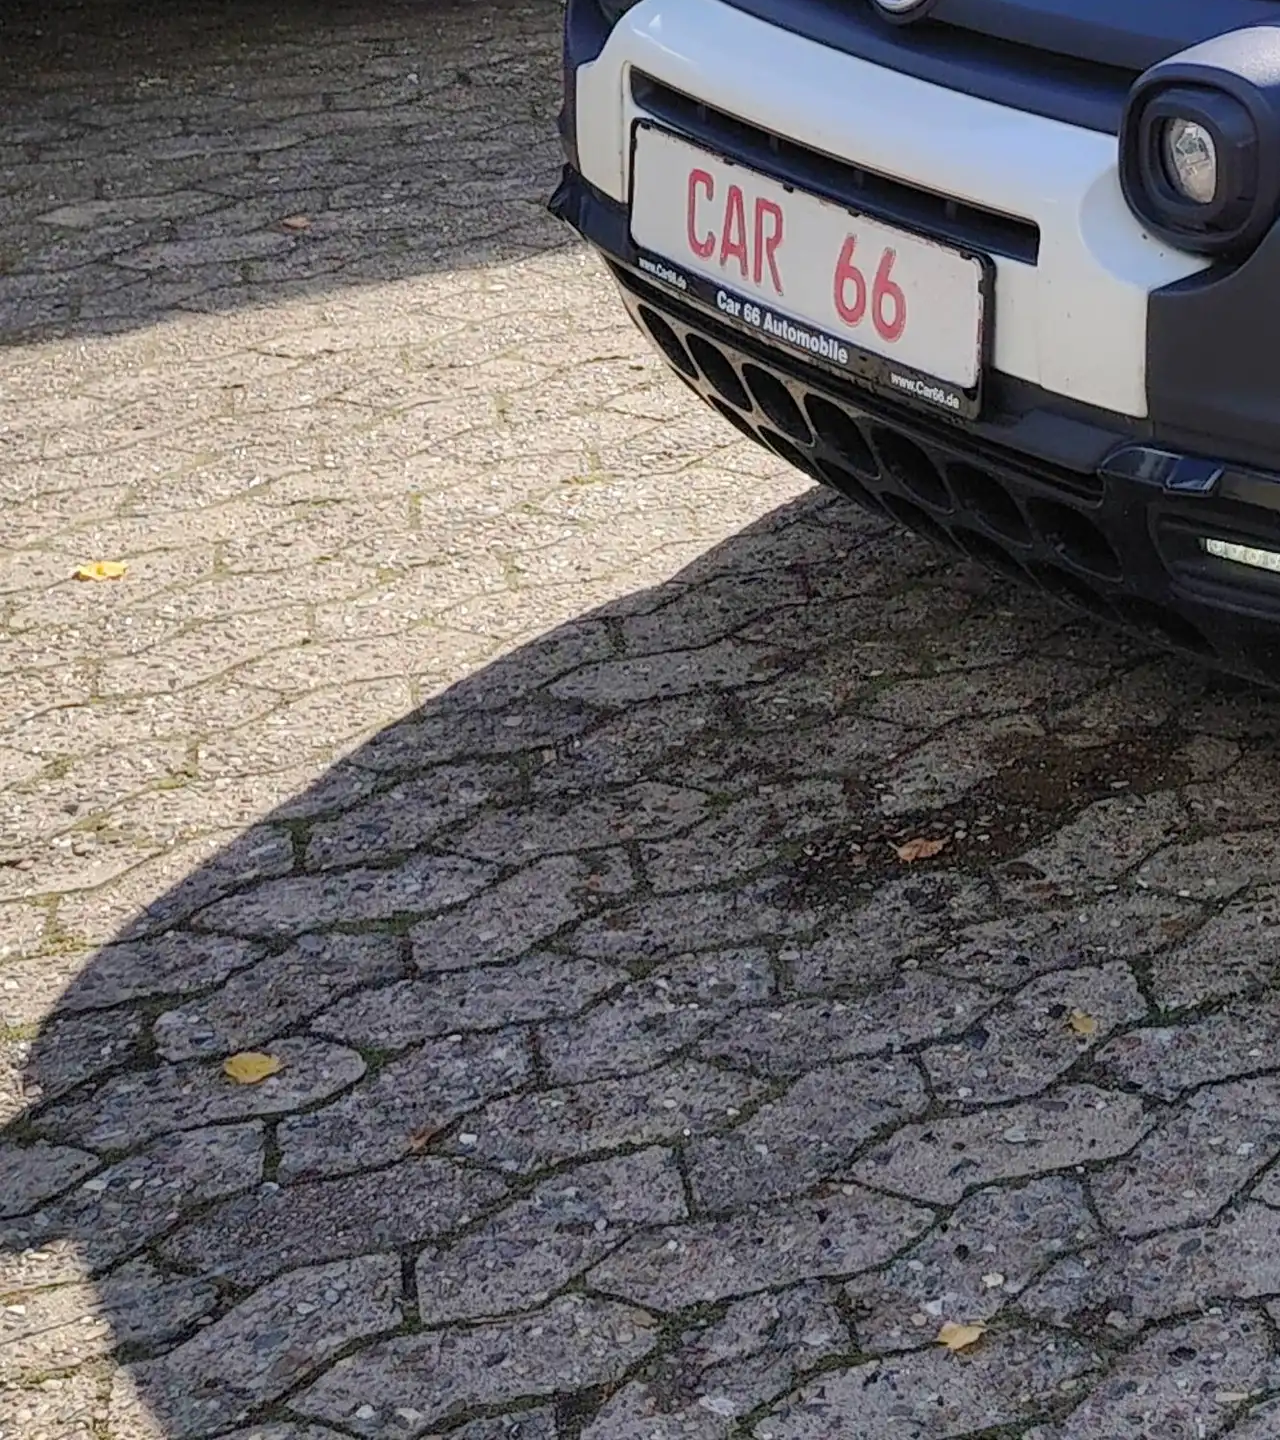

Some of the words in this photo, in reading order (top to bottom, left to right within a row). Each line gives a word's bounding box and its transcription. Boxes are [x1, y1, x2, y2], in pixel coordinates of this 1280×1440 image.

[687, 168, 785, 297] CAR
[833, 233, 907, 343] 66
[716, 290, 741, 317] Car
[743, 303, 761, 327] 66
[763, 312, 849, 365] Automobile
